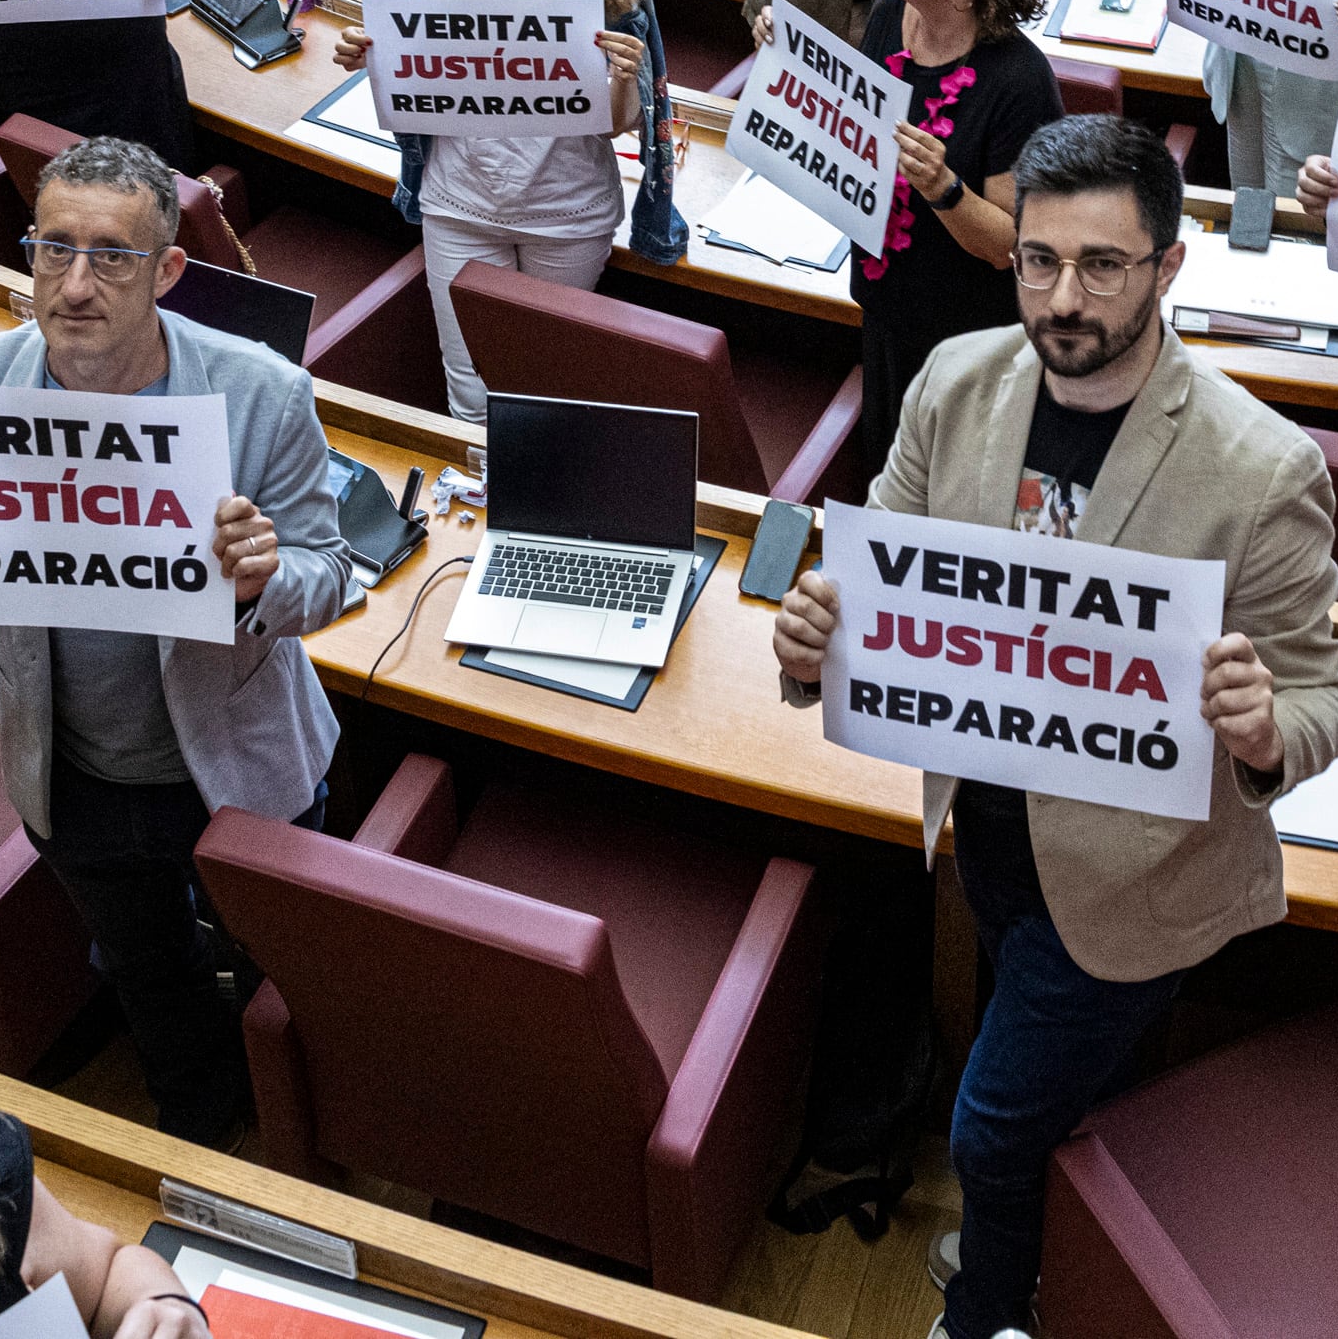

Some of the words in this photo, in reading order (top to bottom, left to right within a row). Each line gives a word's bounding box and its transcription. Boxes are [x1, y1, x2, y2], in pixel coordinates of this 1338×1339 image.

[390, 13, 573, 41] VERITAT
[394, 46, 580, 81] JUSTÍCIA
[783, 19, 887, 119] VERITAT
[392, 88, 591, 115] REPARACIÓ
[766, 67, 880, 171] JUSTÍCIA
[744, 109, 878, 217] REPARACIÓ
[867, 540, 1171, 634] VERITAT
[862, 610, 1169, 703] JUSTÍCIA
[849, 679, 1179, 771] REPARACIÓ
